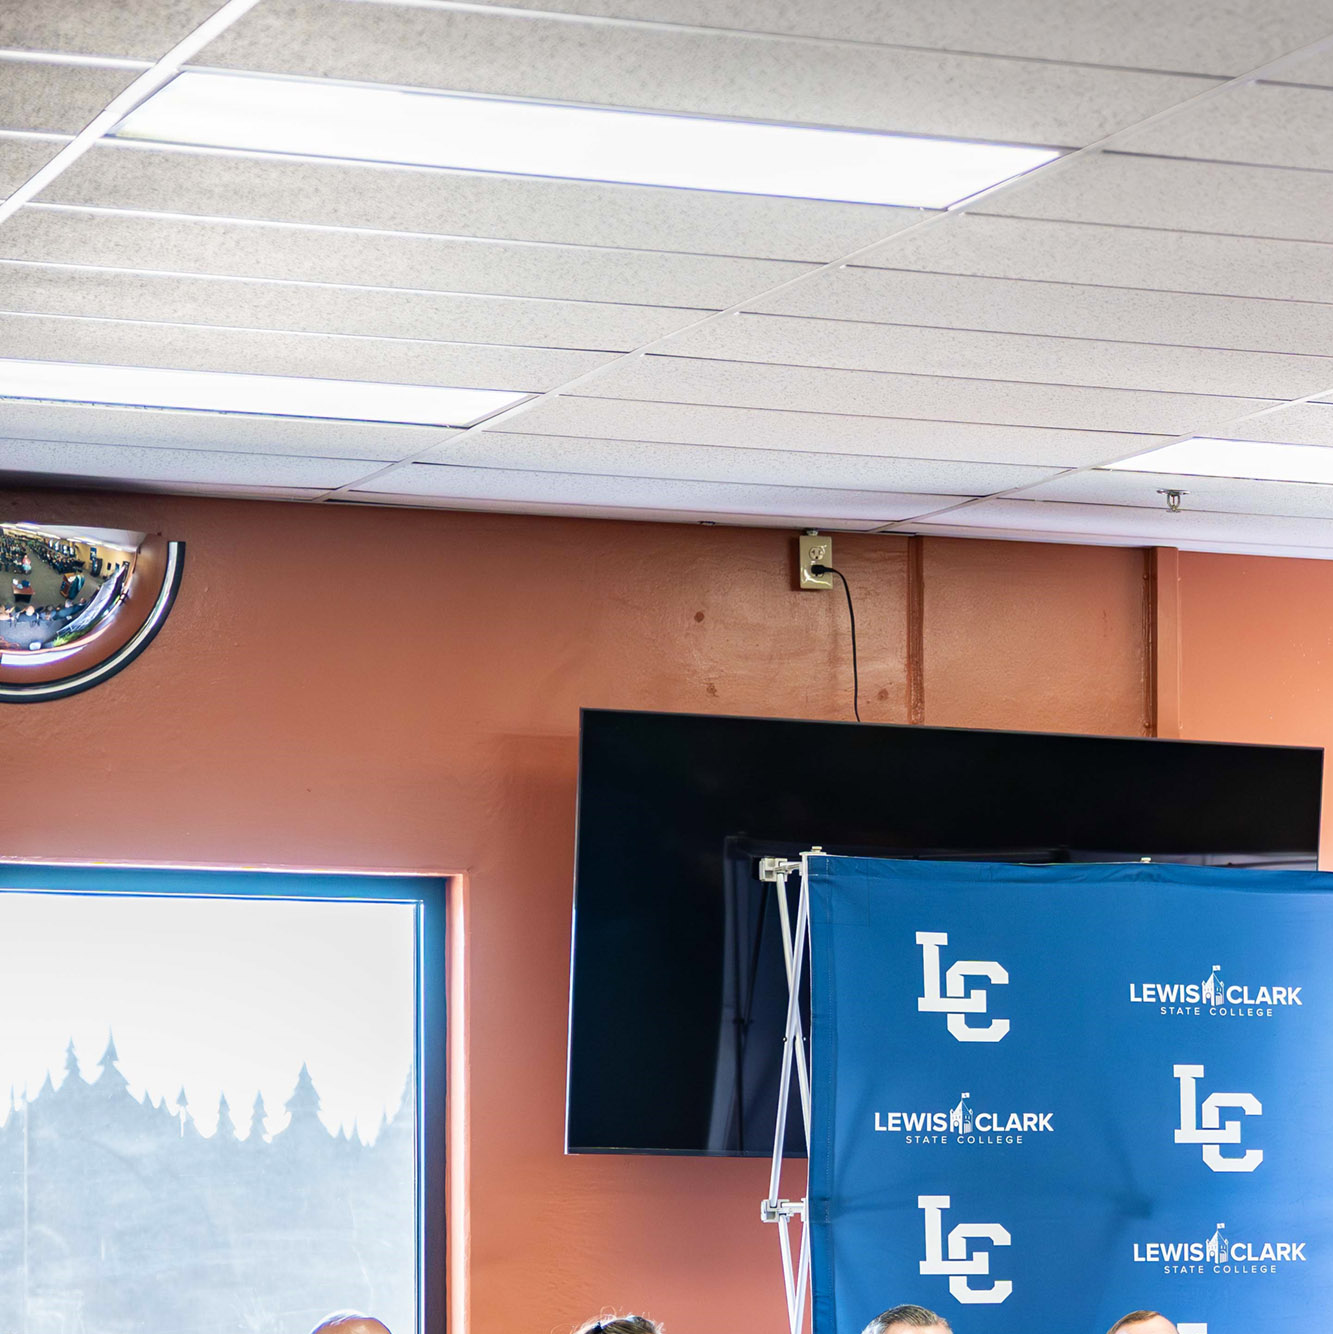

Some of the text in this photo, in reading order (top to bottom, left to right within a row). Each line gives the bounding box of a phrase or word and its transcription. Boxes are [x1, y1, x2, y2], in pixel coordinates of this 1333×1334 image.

[916, 932, 1009, 1042] LC
[1129, 983, 1303, 1006] LEWIS CLARK
[1160, 1006, 1273, 1017] STATE COLLEGE
[874, 1112, 1054, 1132] LEWIS CLARK
[1174, 1065, 1263, 1172] LC
[905, 1135, 1023, 1144] STATE COLLEGE
[918, 1196, 1012, 1303] LC
[1133, 1242, 1307, 1262] LEWIS CLARK
[1164, 1264, 1277, 1274] STATE COLLEGE
